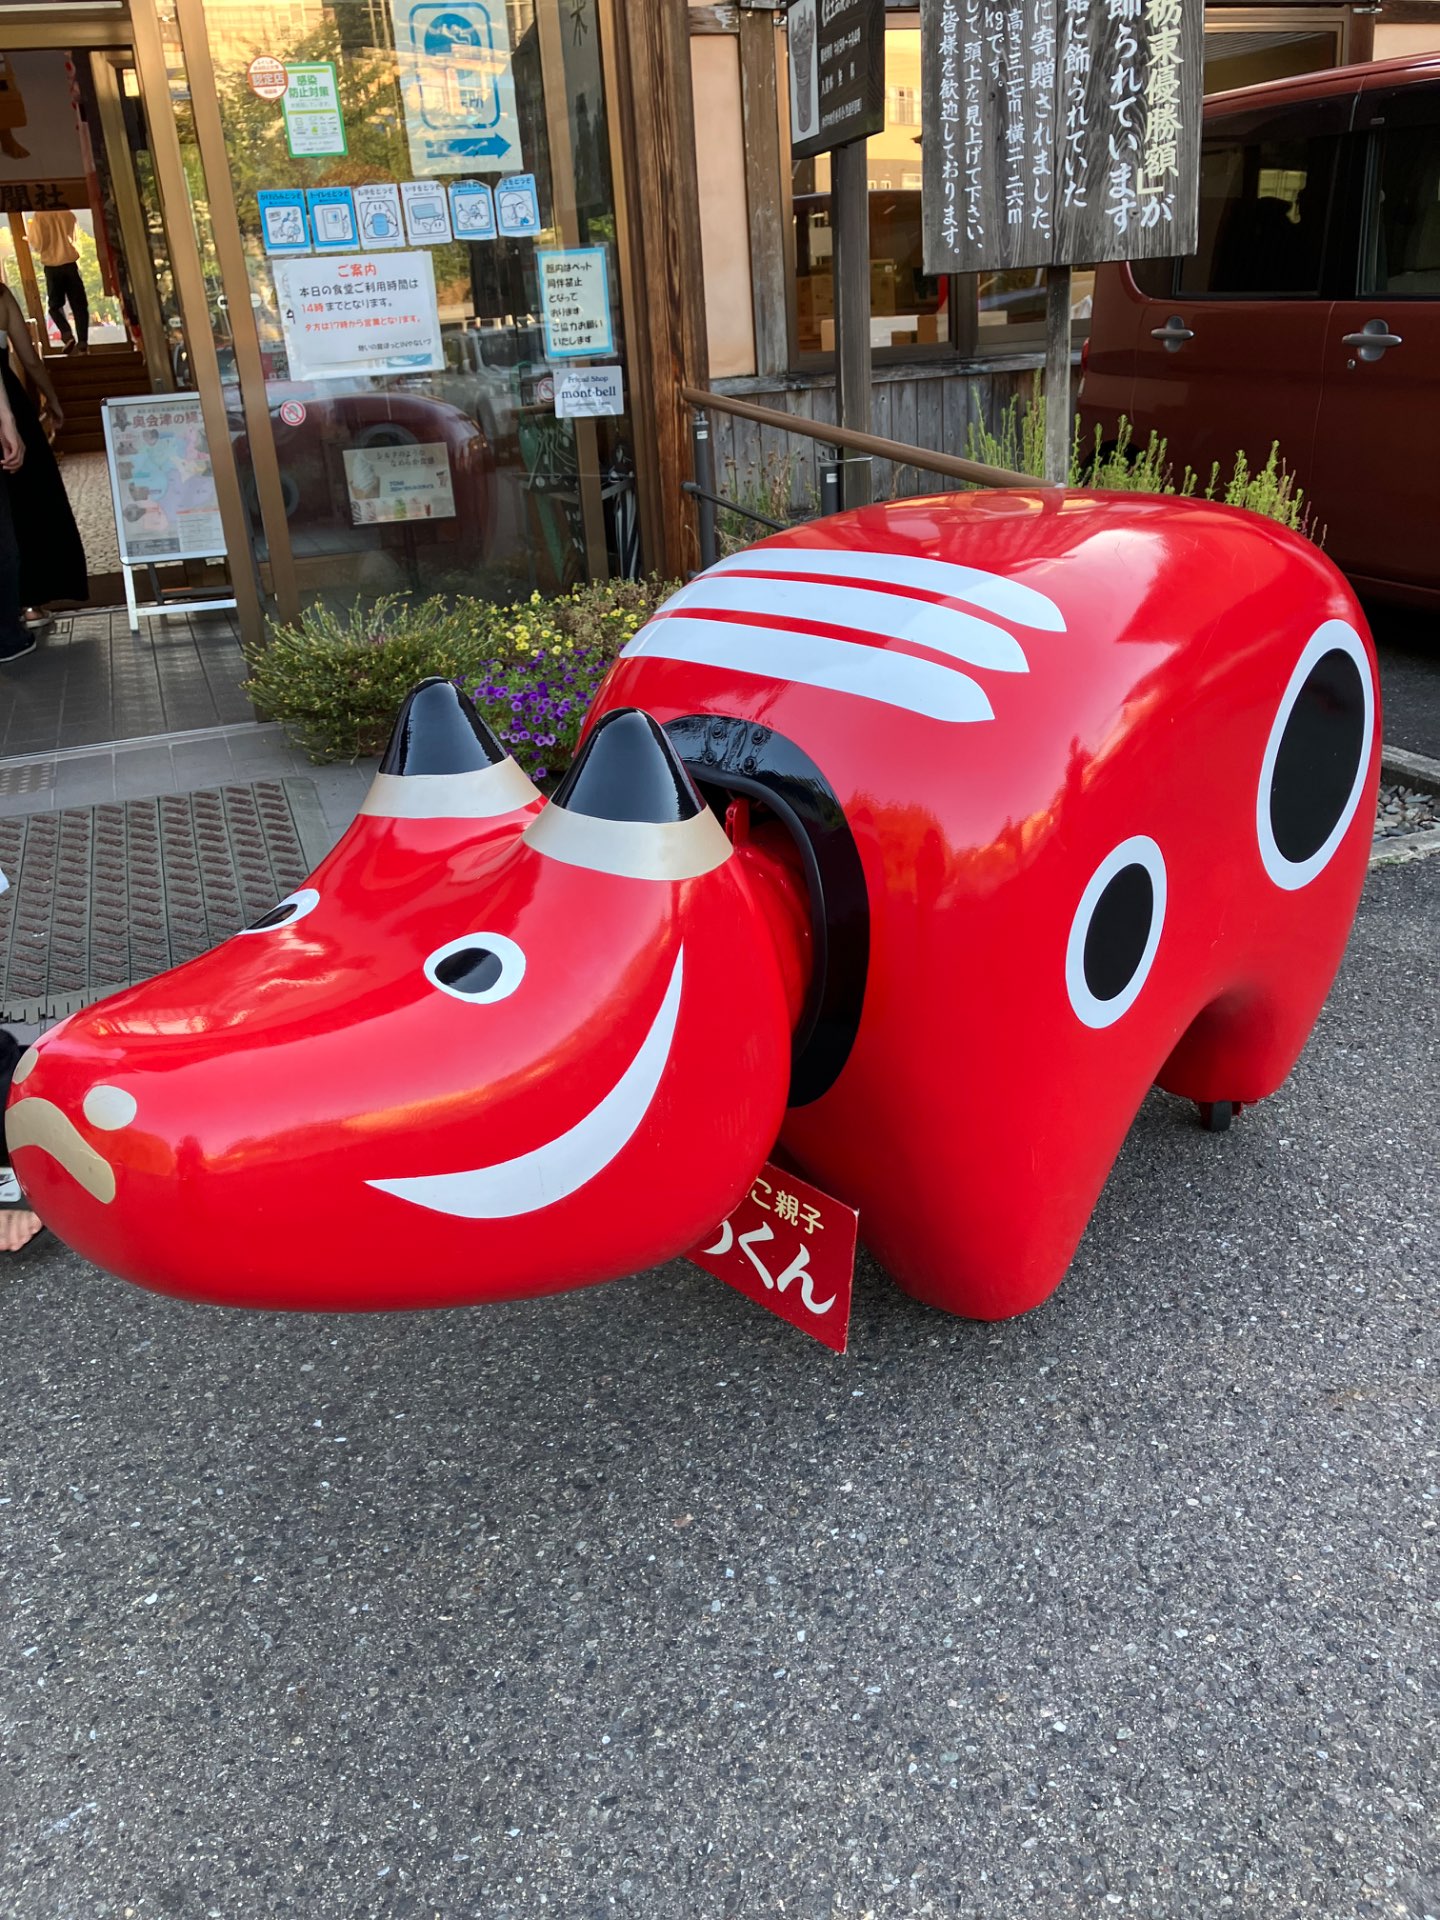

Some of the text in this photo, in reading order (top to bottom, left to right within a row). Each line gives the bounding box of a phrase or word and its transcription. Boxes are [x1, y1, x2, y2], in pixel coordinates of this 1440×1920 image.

[337, 262, 377, 278] ご案内
[299, 278, 419, 299] 本日の食堂ご利用時間は
[548, 292, 579, 303] となって
[552, 335, 592, 347] いたします
[591, 375, 609, 385] Shop
